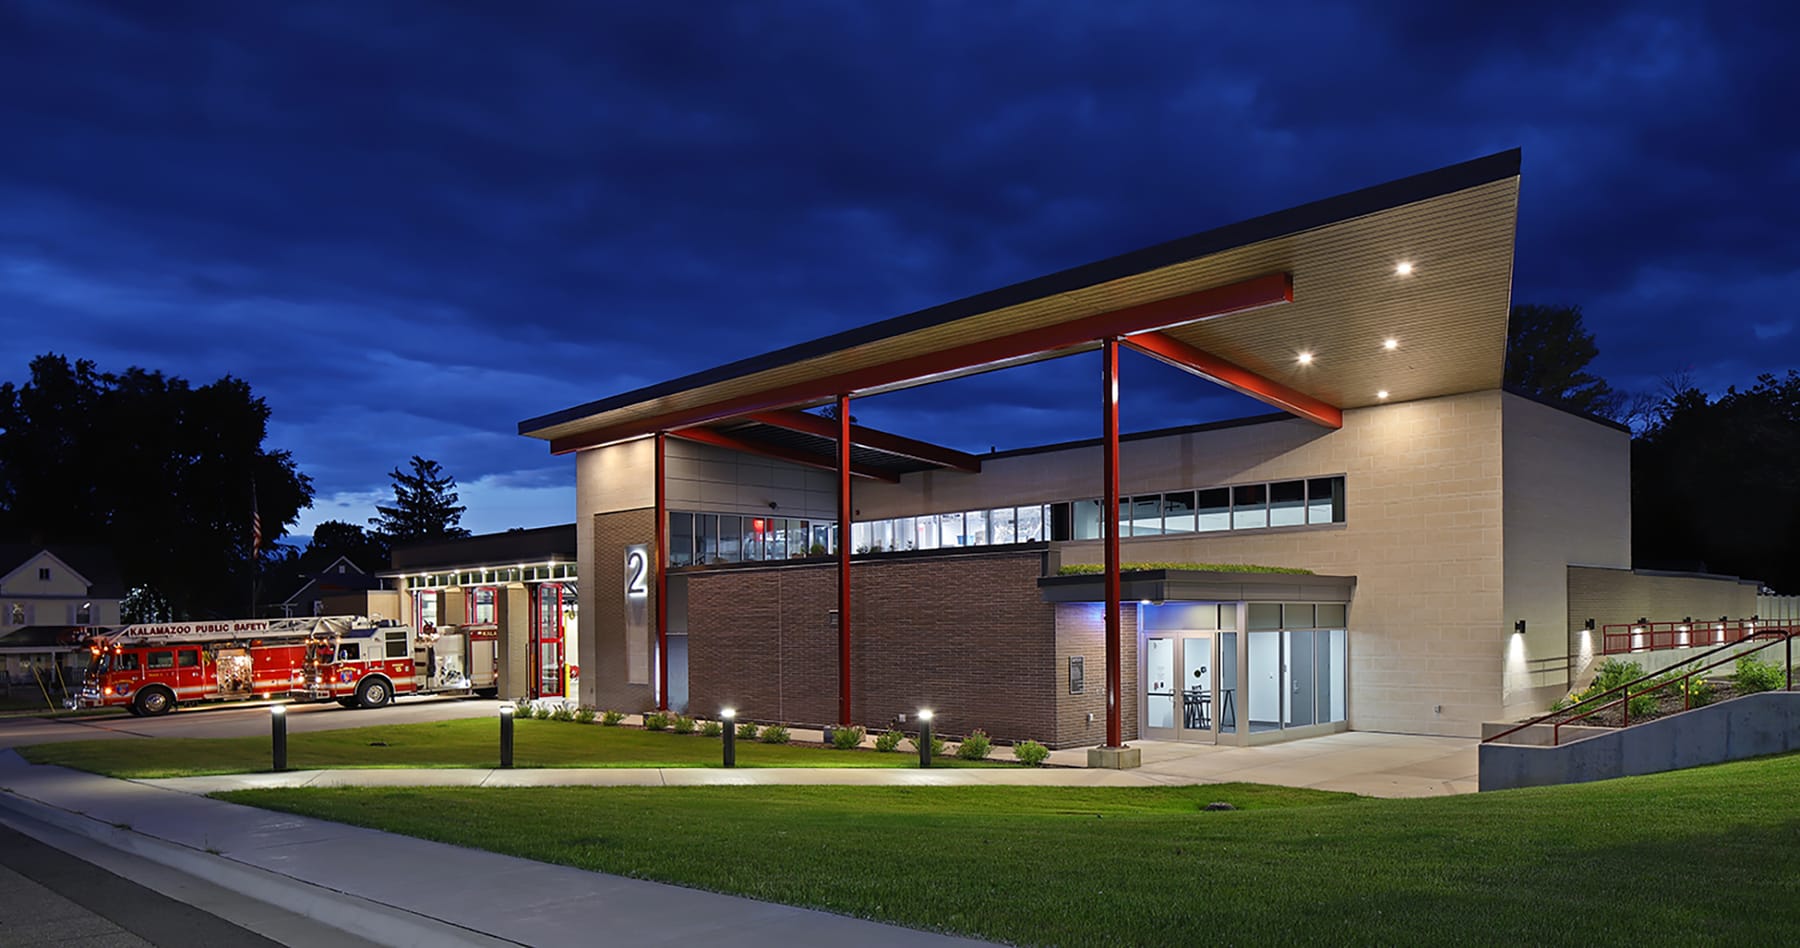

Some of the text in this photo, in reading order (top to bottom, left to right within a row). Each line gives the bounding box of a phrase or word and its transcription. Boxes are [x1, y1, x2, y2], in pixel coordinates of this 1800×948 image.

[627, 551, 645, 594] 2
[129, 622, 267, 636] KALAMAZOO PUBLIC SAFETY
